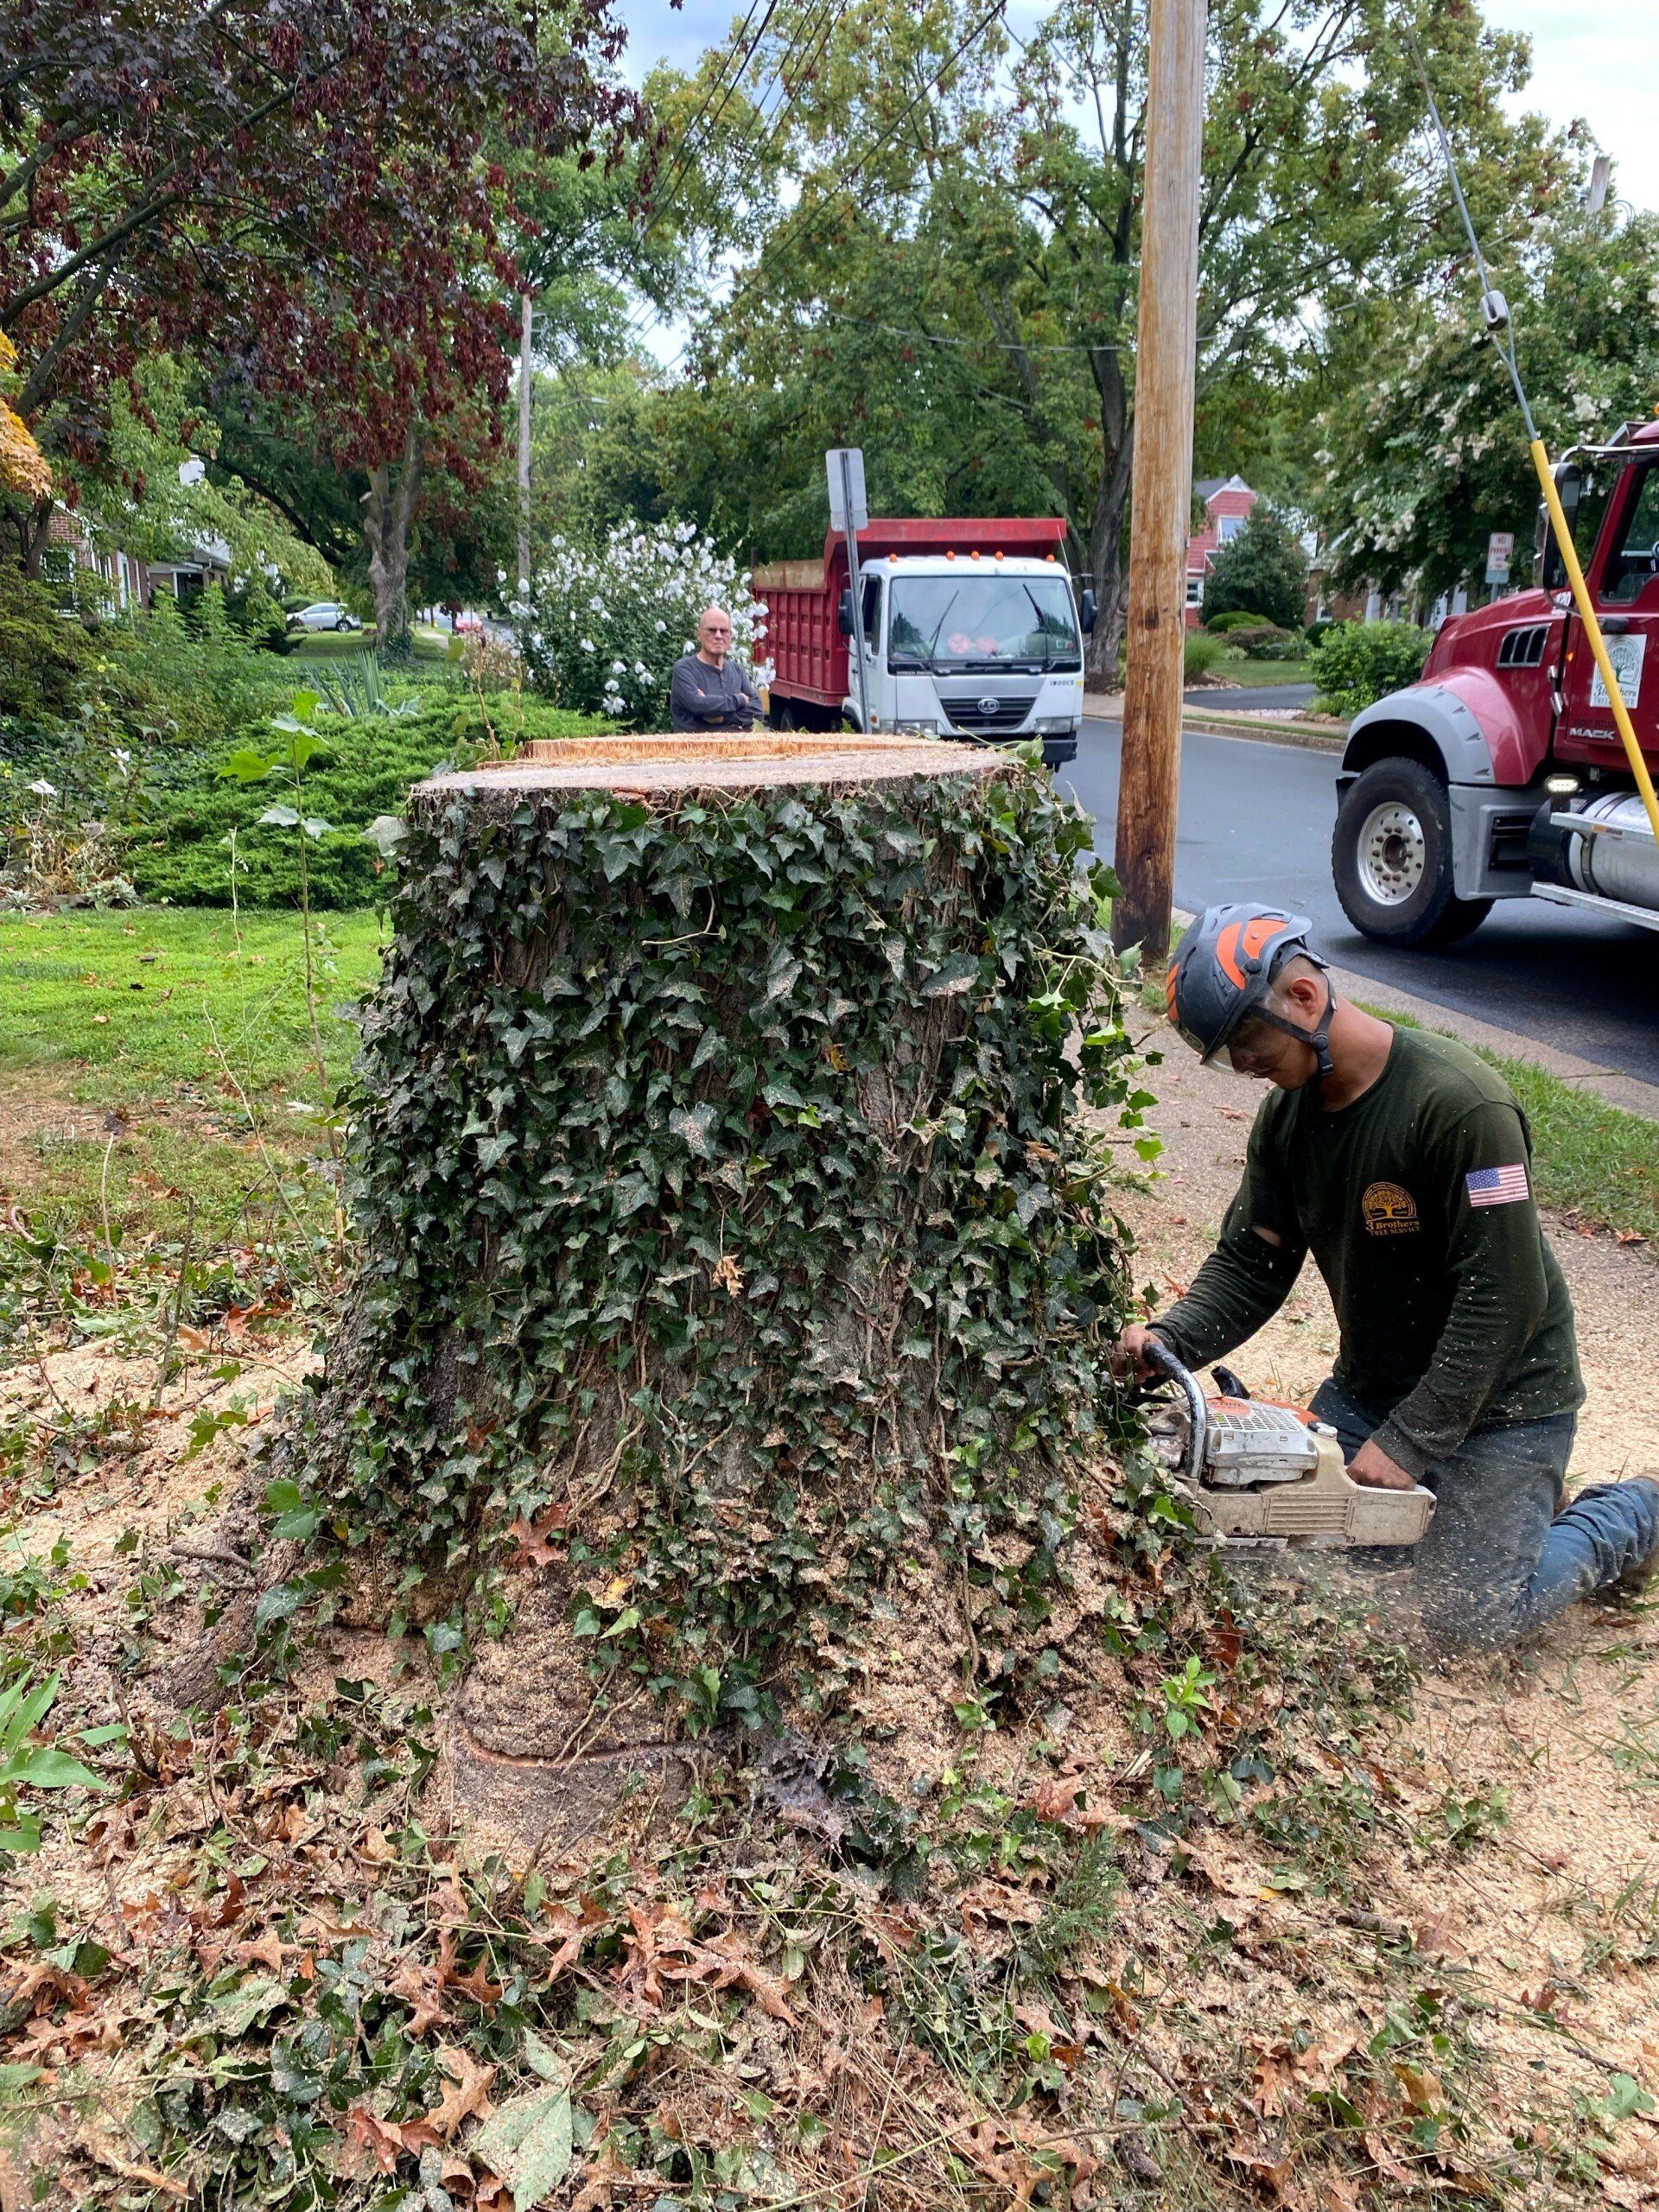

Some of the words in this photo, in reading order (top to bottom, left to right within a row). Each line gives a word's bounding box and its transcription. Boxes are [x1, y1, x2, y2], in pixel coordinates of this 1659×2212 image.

[1569, 728, 1616, 741] MACK
[1365, 1220, 1375, 1230] 3
[1376, 1220, 1420, 1230] Brothers
